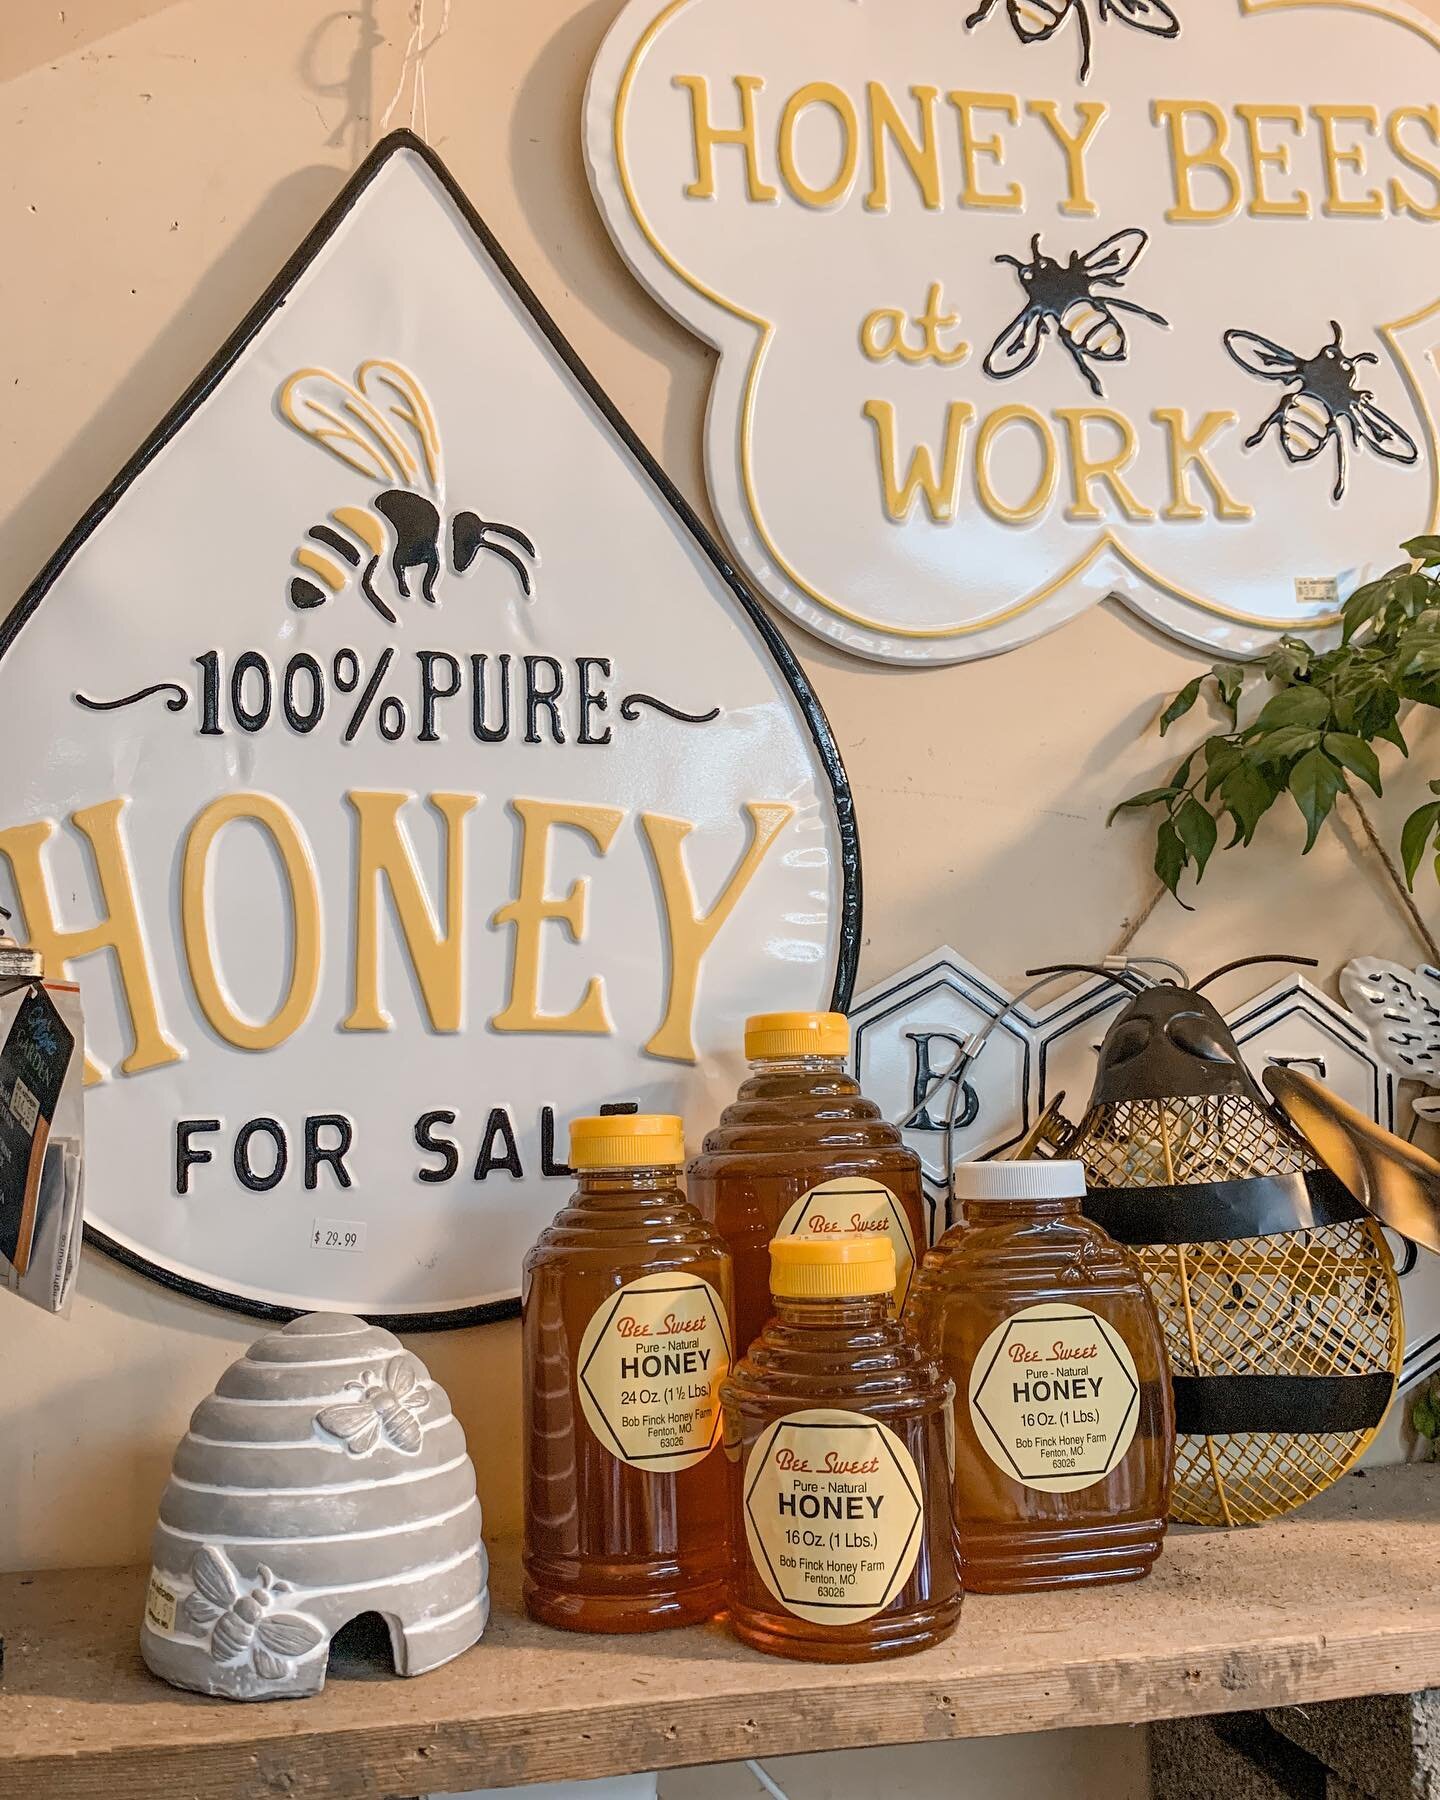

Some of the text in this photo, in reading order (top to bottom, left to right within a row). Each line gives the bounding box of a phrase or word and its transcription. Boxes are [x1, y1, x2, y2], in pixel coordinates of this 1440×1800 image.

[672, 74, 1440, 222] HONEY BEES
[862, 284, 968, 364] at
[864, 400, 1254, 522] WORK
[196, 648, 612, 744] 100% PURE
[0, 791, 797, 1085] HONEY
[176, 1103, 638, 1194] FOR SAL
[809, 1213, 889, 1233] Bee Sweet
[314, 1230, 356, 1246] $ 29.99
[617, 1313, 707, 1338] Bee Sweet
[636, 1343, 660, 1354] Pure
[668, 1338, 700, 1351] Natural
[1008, 1340, 1098, 1363] Bee Sweet
[621, 1349, 711, 1379] HONEY
[1026, 1369, 1049, 1379] Pure
[1056, 1366, 1089, 1377] Natural
[621, 1390, 637, 1405] 24
[639, 1389, 661, 1404] Oz.
[688, 1382, 711, 1399] Lbs.)
[1012, 1376, 1103, 1403] HONEY
[622, 1407, 712, 1427] Bob Finck Honey Farm
[1020, 1408, 1100, 1428] 16 Oz. (1 Lbs.)
[648, 1426, 677, 1438] Fenton,
[1015, 1433, 1107, 1448] Bob Finck Honey Farm
[660, 1437, 684, 1448] 63026
[775, 1448, 880, 1474] Bee Sweet
[1040, 1448, 1069, 1459] Fenton,
[1052, 1458, 1076, 1469] 63026
[793, 1479, 818, 1492] Pure
[828, 1482, 867, 1493] Natural
[778, 1492, 885, 1520] HONEY
[785, 1529, 878, 1551] 16 Oz. (1 Lbs.)
[779, 1555, 885, 1574] Bob Finck Honey Farm
[804, 1572, 836, 1585] Fenton,
[817, 1587, 845, 1597] 63026
